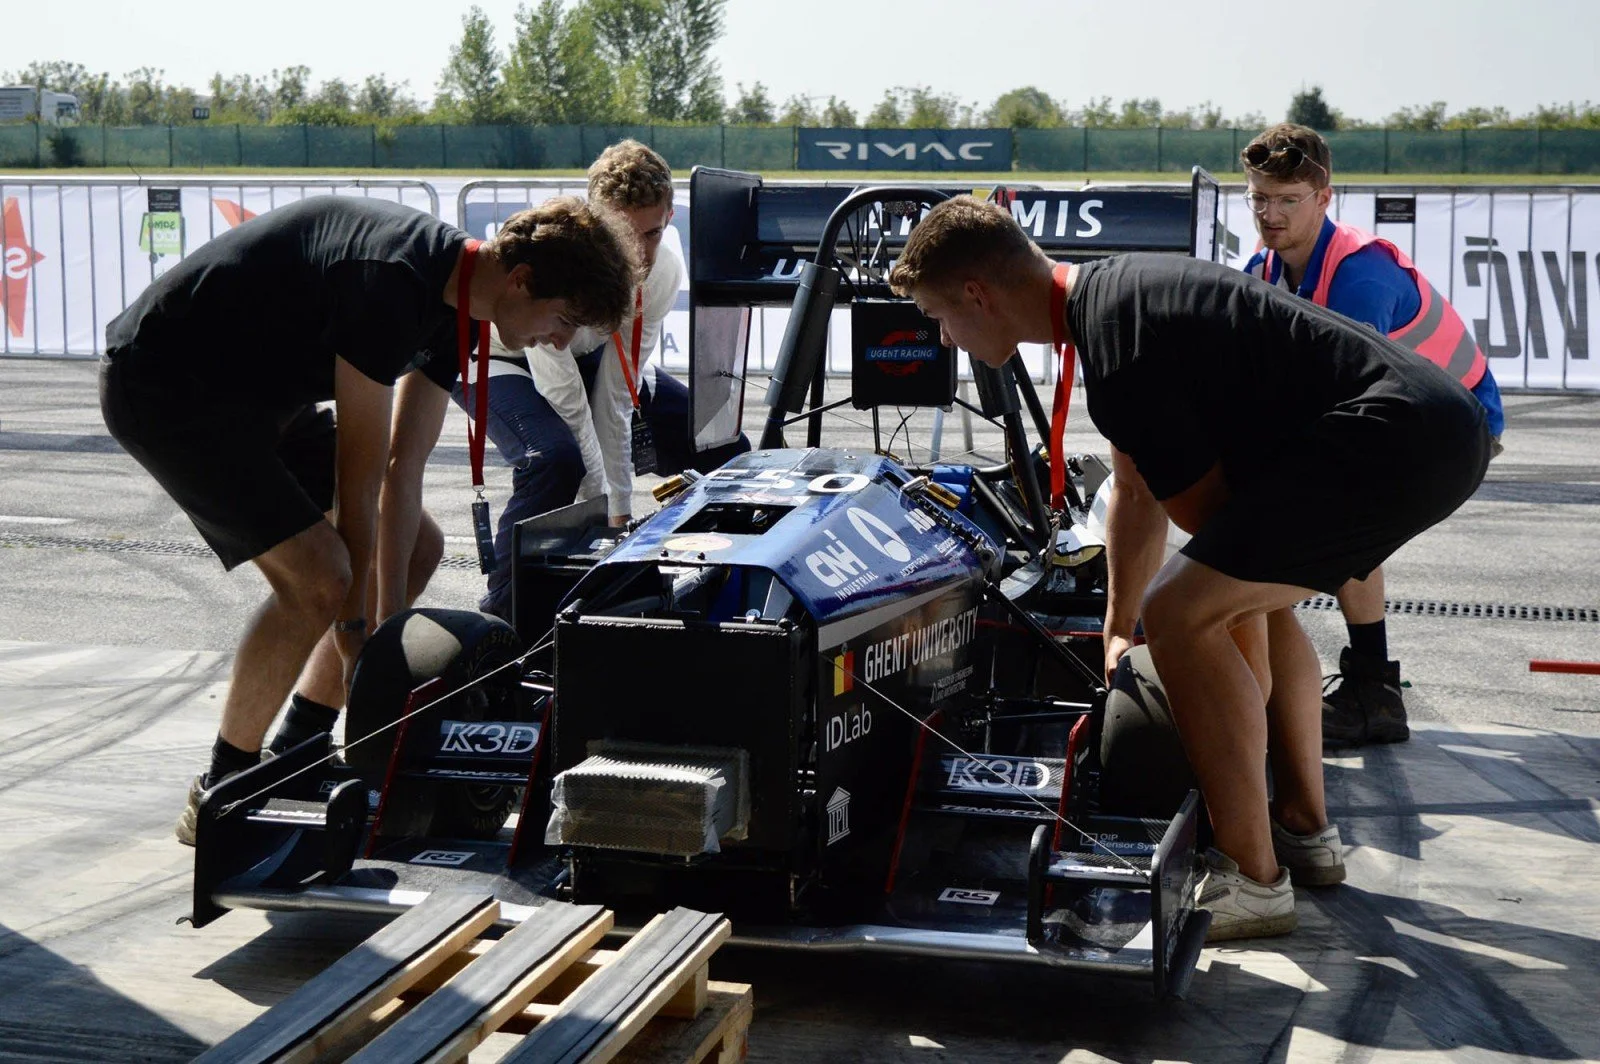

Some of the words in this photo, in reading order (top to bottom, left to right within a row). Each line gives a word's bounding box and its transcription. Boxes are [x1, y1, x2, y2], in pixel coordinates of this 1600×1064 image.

[815, 141, 994, 161] RIMAC
[870, 349, 899, 358] UGENT
[900, 349, 932, 358] RACING
[834, 571, 878, 601] INDUSTRIAL
[864, 632, 909, 684] GHENT
[912, 606, 979, 666] UNIVERSITY
[441, 723, 539, 753] K3D
[826, 702, 872, 752] IDLab
[947, 757, 1051, 790] K3D
[420, 852, 466, 862] RS
[946, 890, 992, 901] RS
